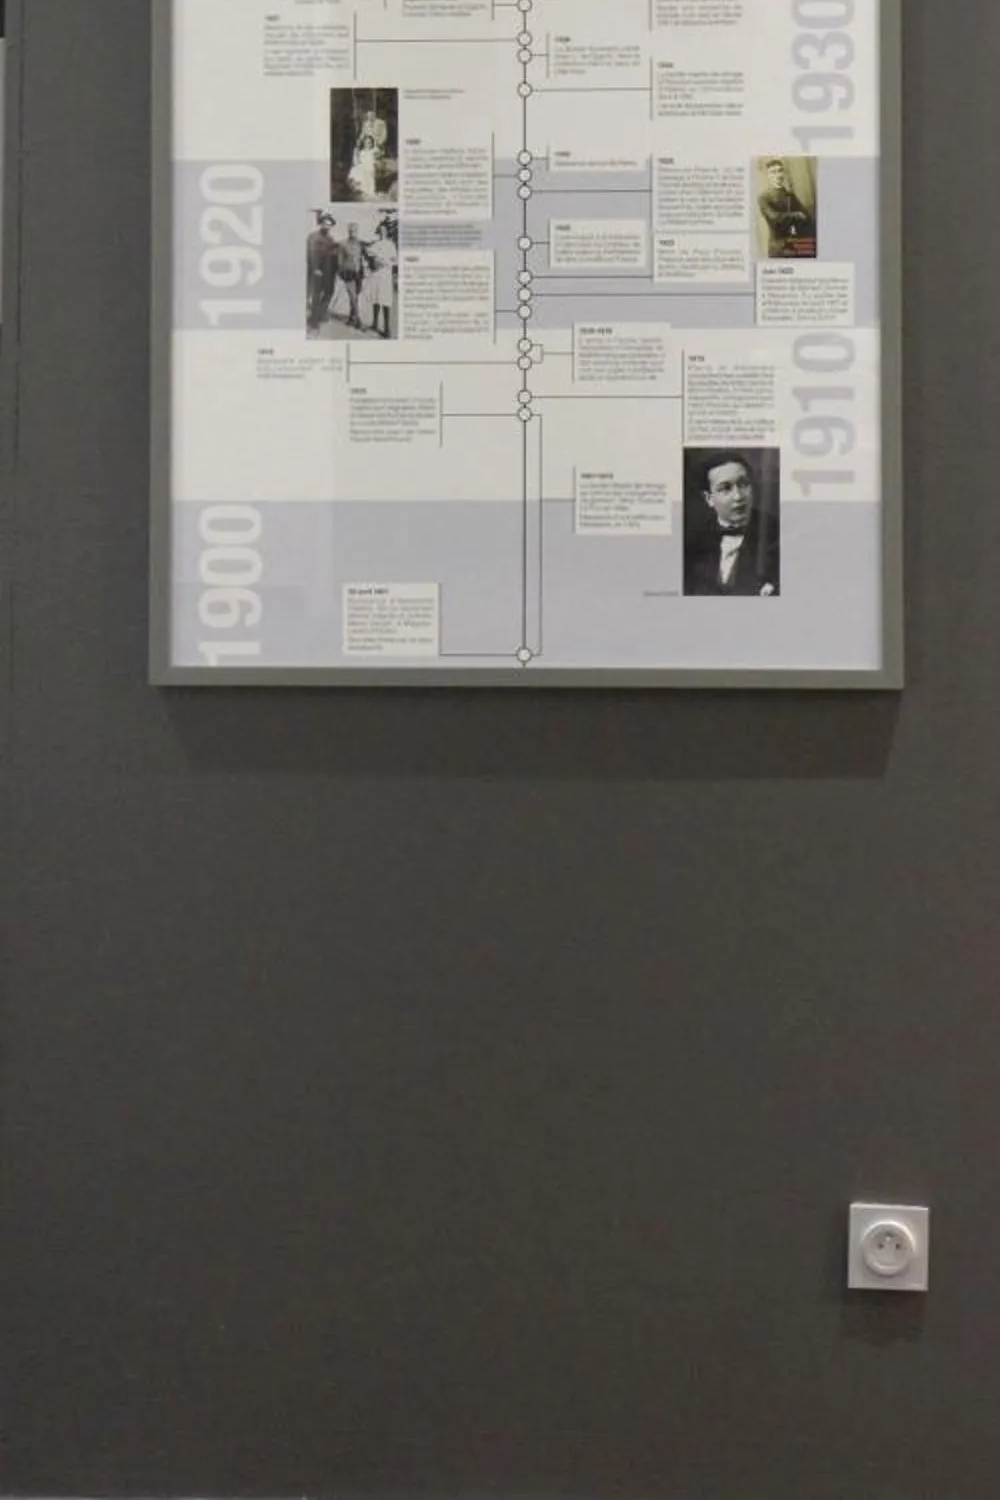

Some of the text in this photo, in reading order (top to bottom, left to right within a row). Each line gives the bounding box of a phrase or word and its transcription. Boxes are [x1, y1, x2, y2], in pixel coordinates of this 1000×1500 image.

[200, 164, 264, 326] 1920
[792, 332, 856, 497] 1910
[198, 504, 262, 666] 1900
